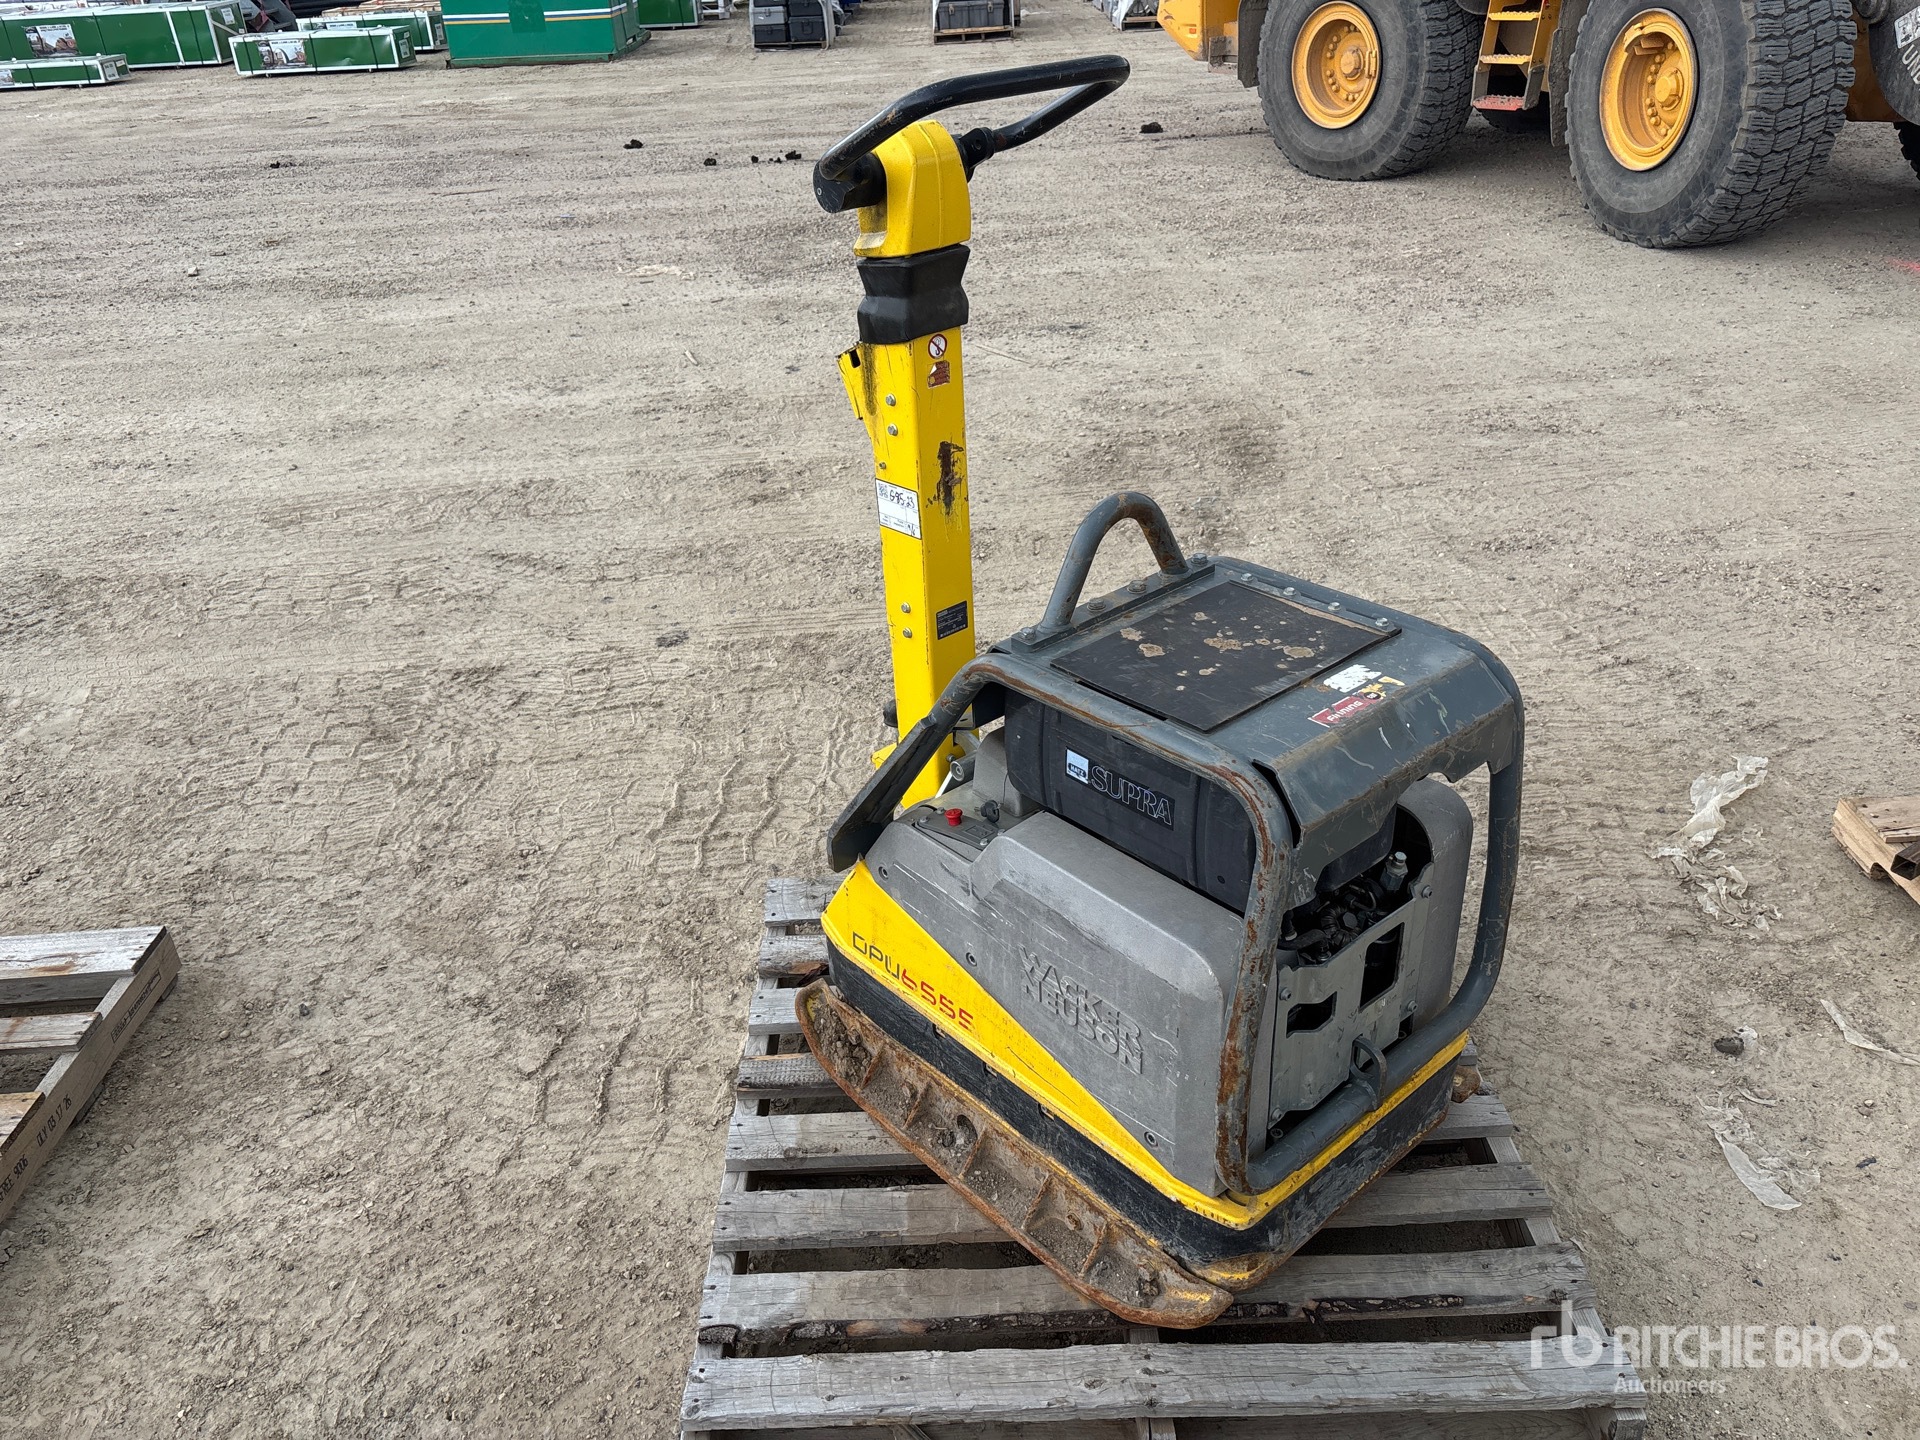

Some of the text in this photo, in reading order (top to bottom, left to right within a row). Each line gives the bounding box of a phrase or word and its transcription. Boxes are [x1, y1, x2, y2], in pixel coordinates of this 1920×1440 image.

[1091, 765, 1172, 826] SUPRA
[1018, 943, 1143, 1052] WACKER
[1020, 970, 1143, 1075] NEUSON
